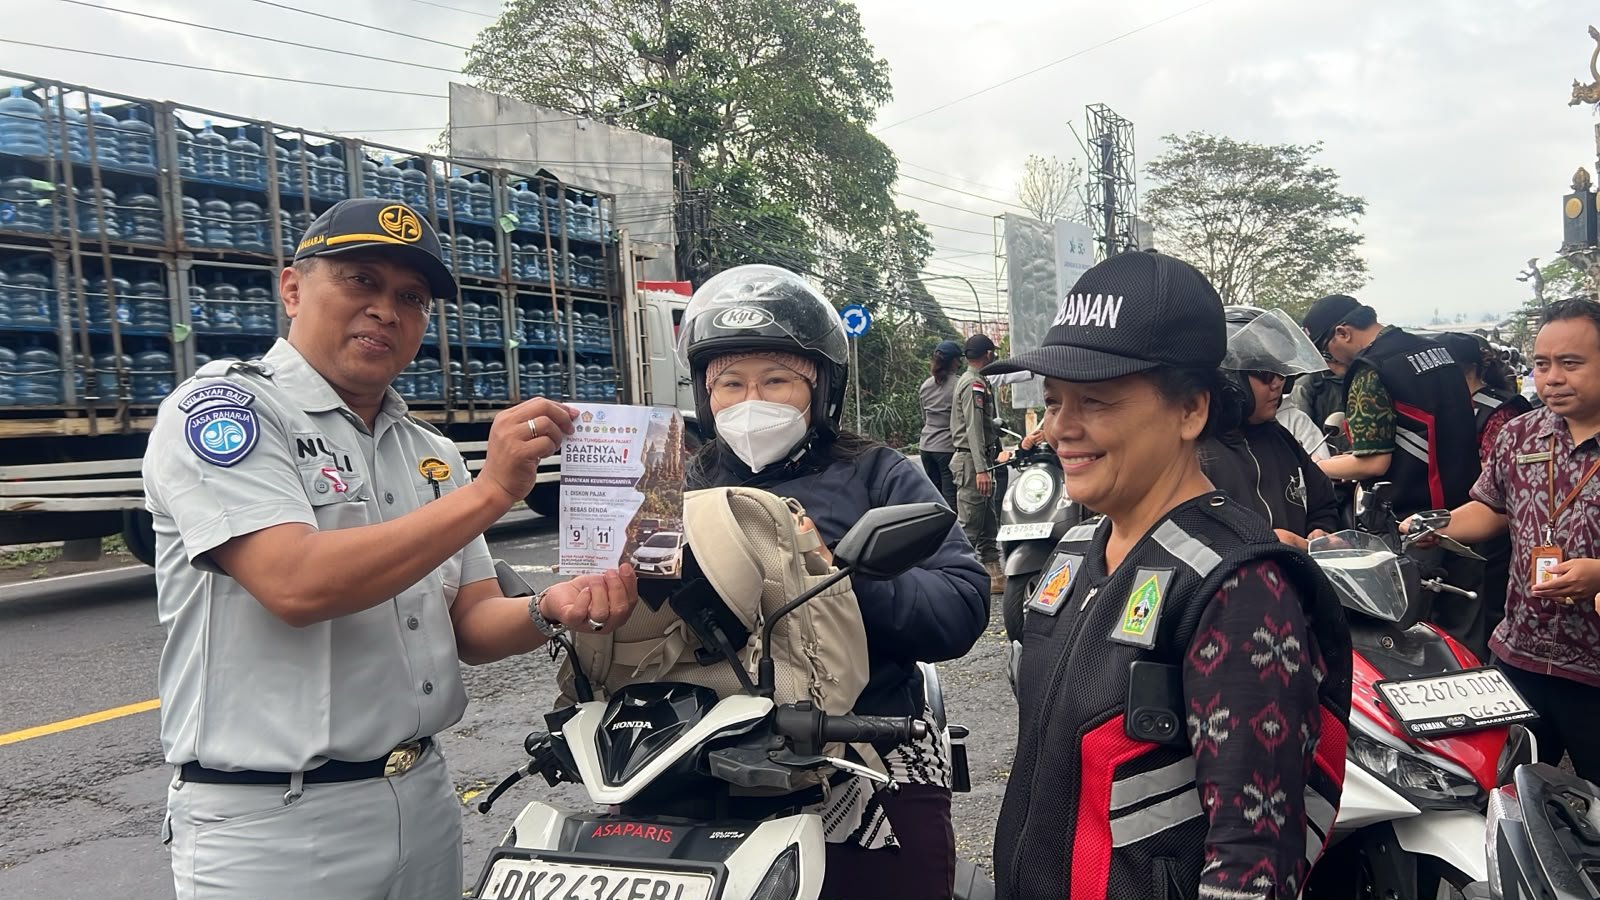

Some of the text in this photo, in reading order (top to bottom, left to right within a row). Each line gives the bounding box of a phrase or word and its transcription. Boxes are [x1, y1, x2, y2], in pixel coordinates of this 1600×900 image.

[183, 389, 247, 406] WILAYAH BALI
[192, 411, 250, 428] JASA RAHARJA
[566, 444, 616, 454] SAATNYA
[573, 530, 581, 542] 9
[597, 532, 609, 543] 11
[1466, 674, 1511, 696] DDM
[611, 721, 653, 730] HONDA
[1419, 721, 1447, 731] YAMAHA
[591, 823, 673, 843] ASAPARIS
